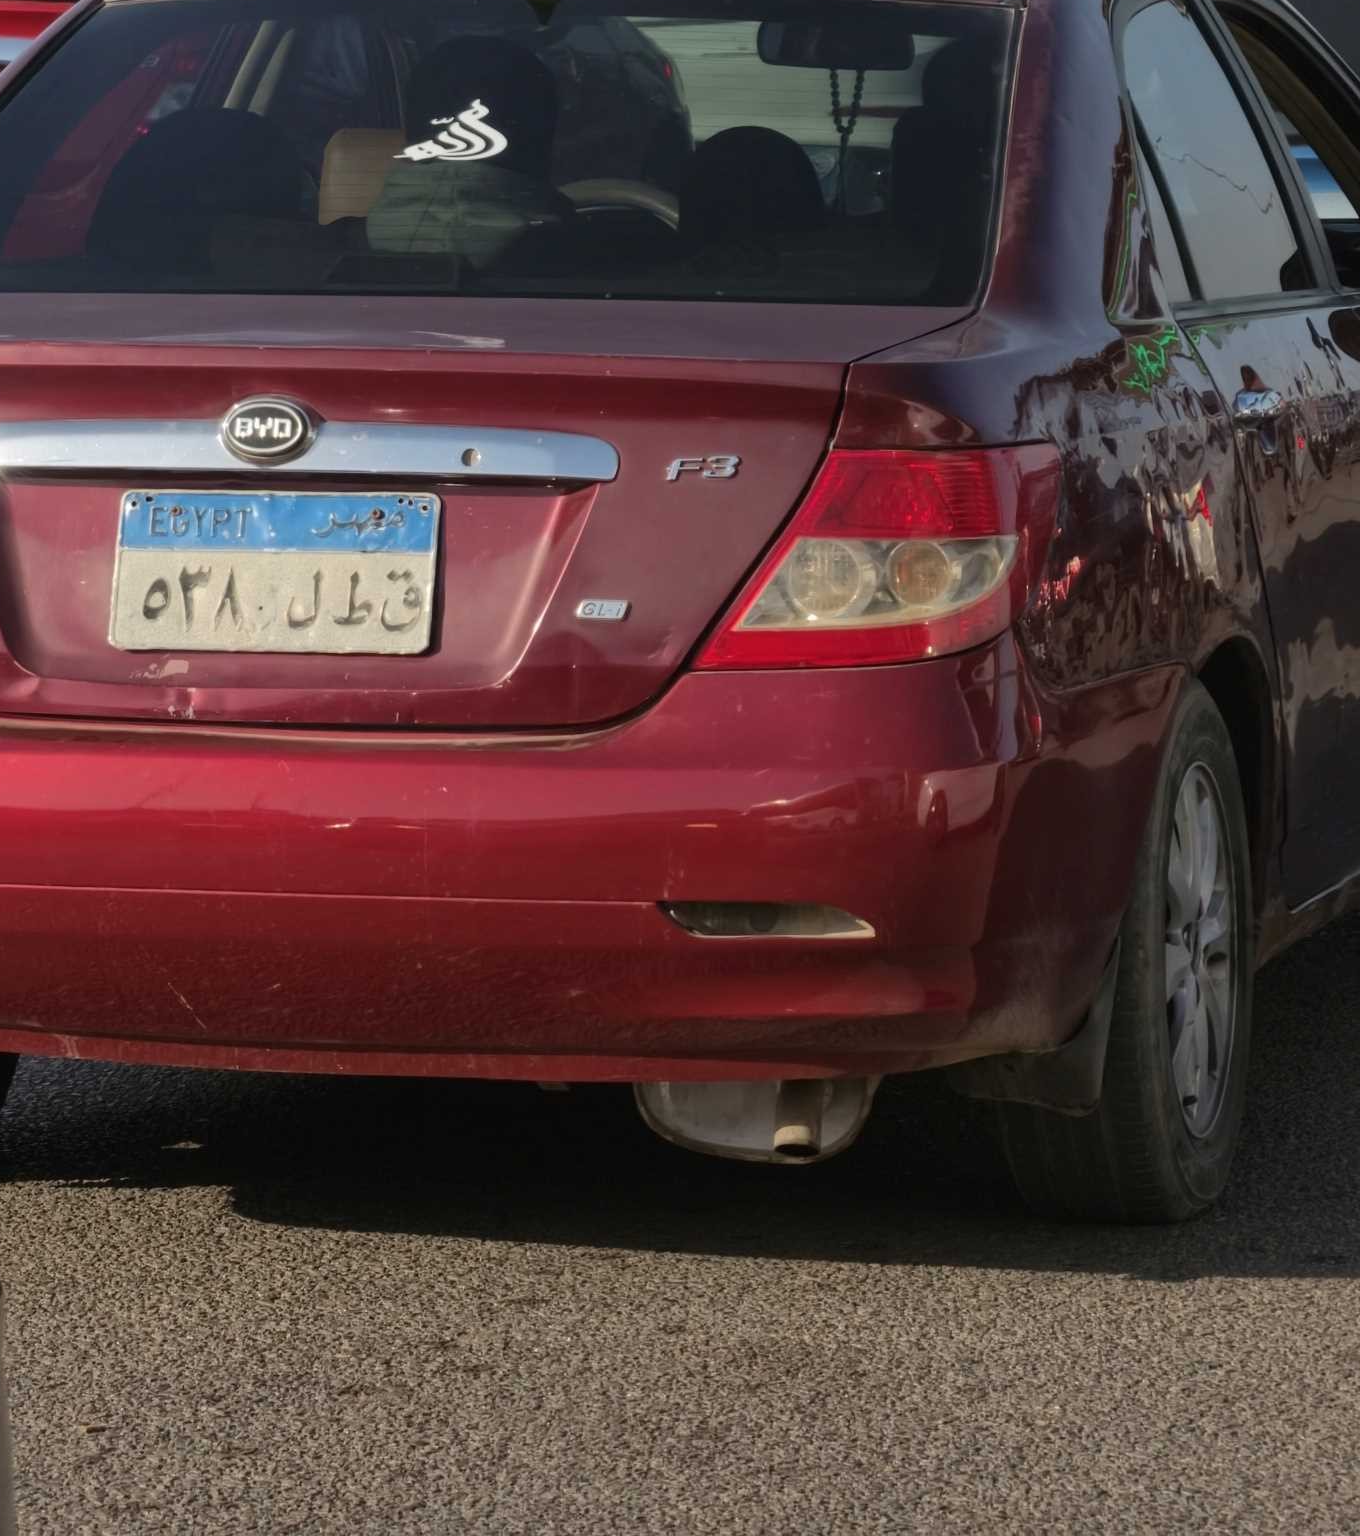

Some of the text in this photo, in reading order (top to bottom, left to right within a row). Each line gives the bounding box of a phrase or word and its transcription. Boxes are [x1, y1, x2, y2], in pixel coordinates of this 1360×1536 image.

[234, 417, 292, 439] BYD
[666, 455, 741, 481] F3
[148, 507, 253, 538] EGYPT
